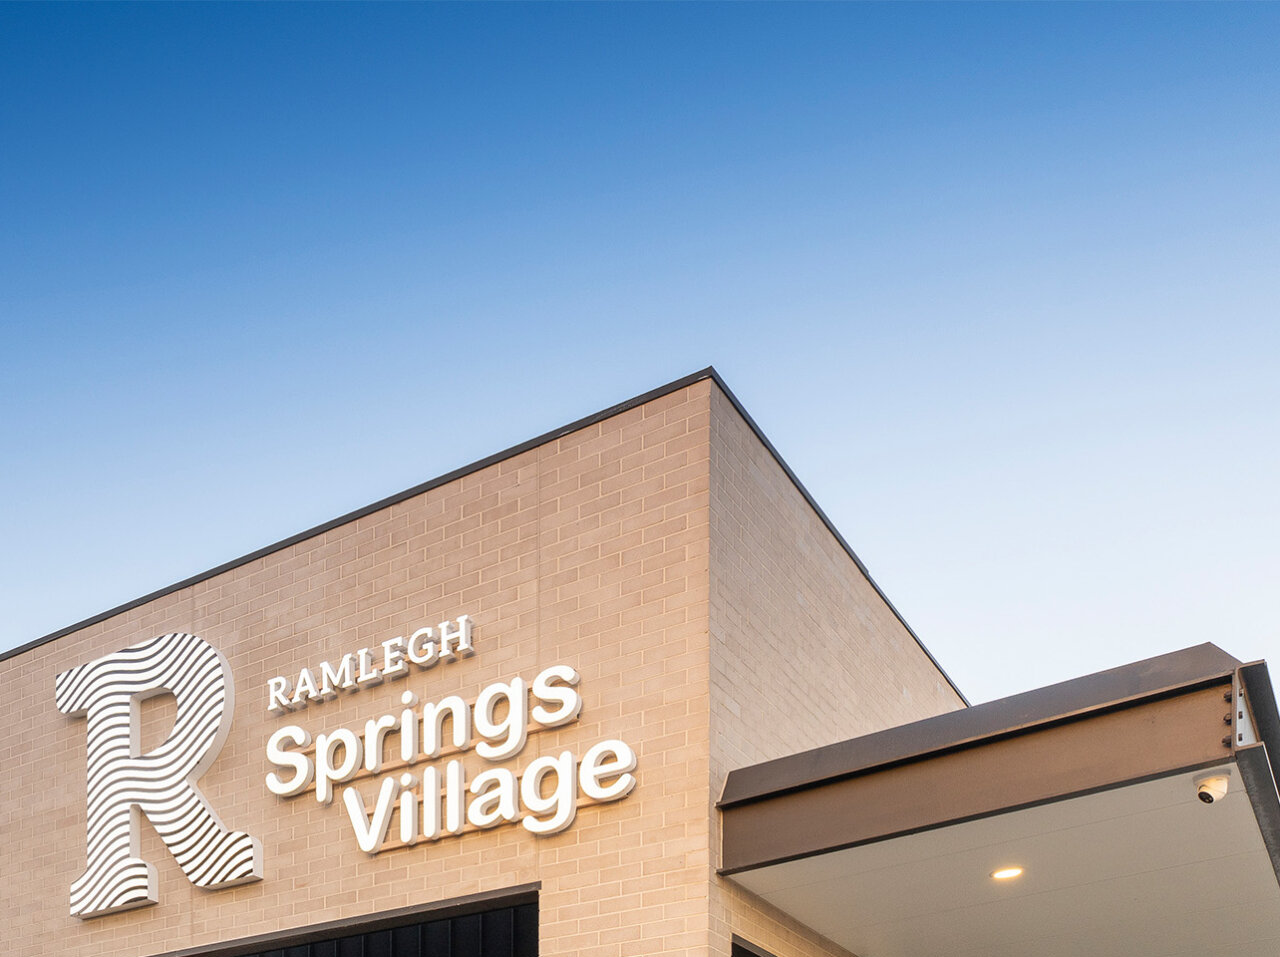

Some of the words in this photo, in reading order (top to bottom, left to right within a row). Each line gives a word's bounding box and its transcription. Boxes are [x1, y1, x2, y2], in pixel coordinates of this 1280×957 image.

[267, 615, 474, 712] RAMLEGH
[55, 632, 263, 919] R
[265, 665, 582, 803] Springs
[342, 738, 637, 855] Village
